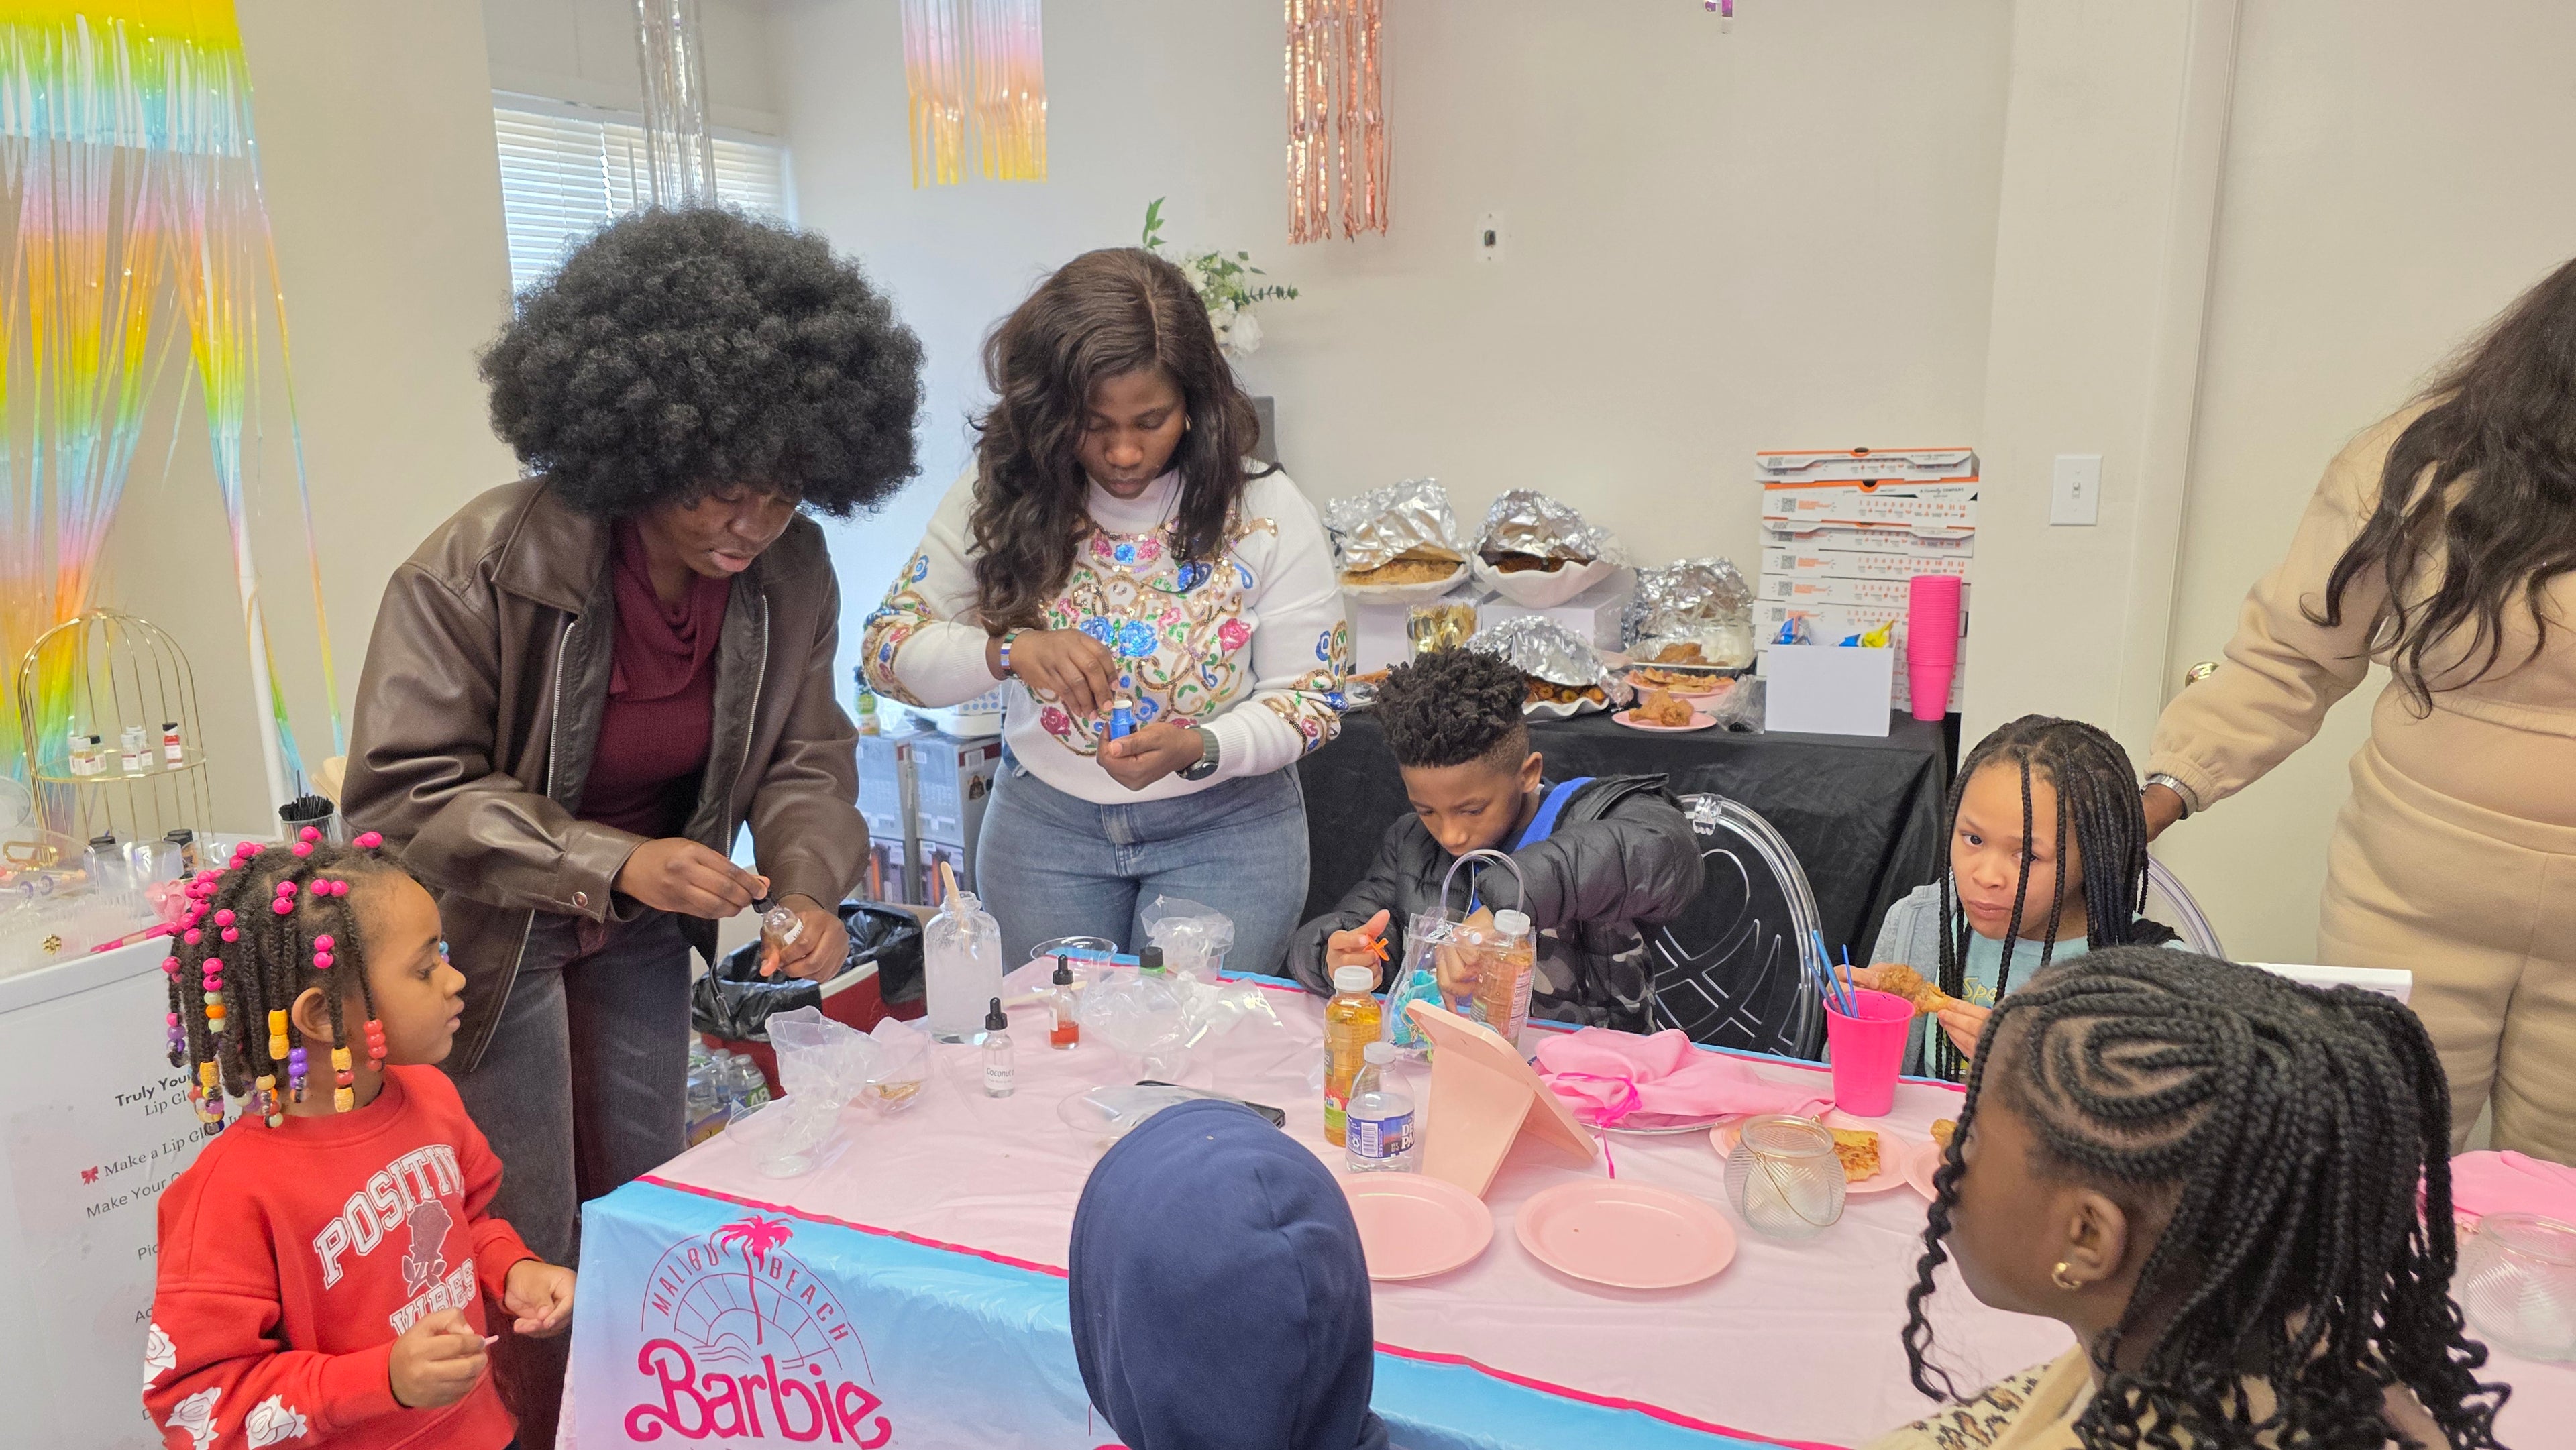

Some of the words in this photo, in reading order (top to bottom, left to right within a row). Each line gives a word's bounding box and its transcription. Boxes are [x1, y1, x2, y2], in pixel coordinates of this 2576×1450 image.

[1962, 977, 1997, 1005] Spo
[986, 1067, 1012, 1077] Coconut
[115, 1085, 155, 1107] Truly
[144, 1100, 168, 1116] Lip
[1401, 1132, 1413, 1149] PA
[1402, 1121, 1414, 1137] DE
[104, 1155, 146, 1176] Make
[150, 1149, 158, 1159] a
[162, 1138, 185, 1154] Lip
[87, 1195, 128, 1218] Make
[131, 1179, 166, 1200] Your
[313, 1144, 465, 1290] POSITIV
[651, 1243, 719, 1317] MALIBU
[769, 1257, 849, 1342] BEACH
[624, 1337, 892, 1450] Barbie
